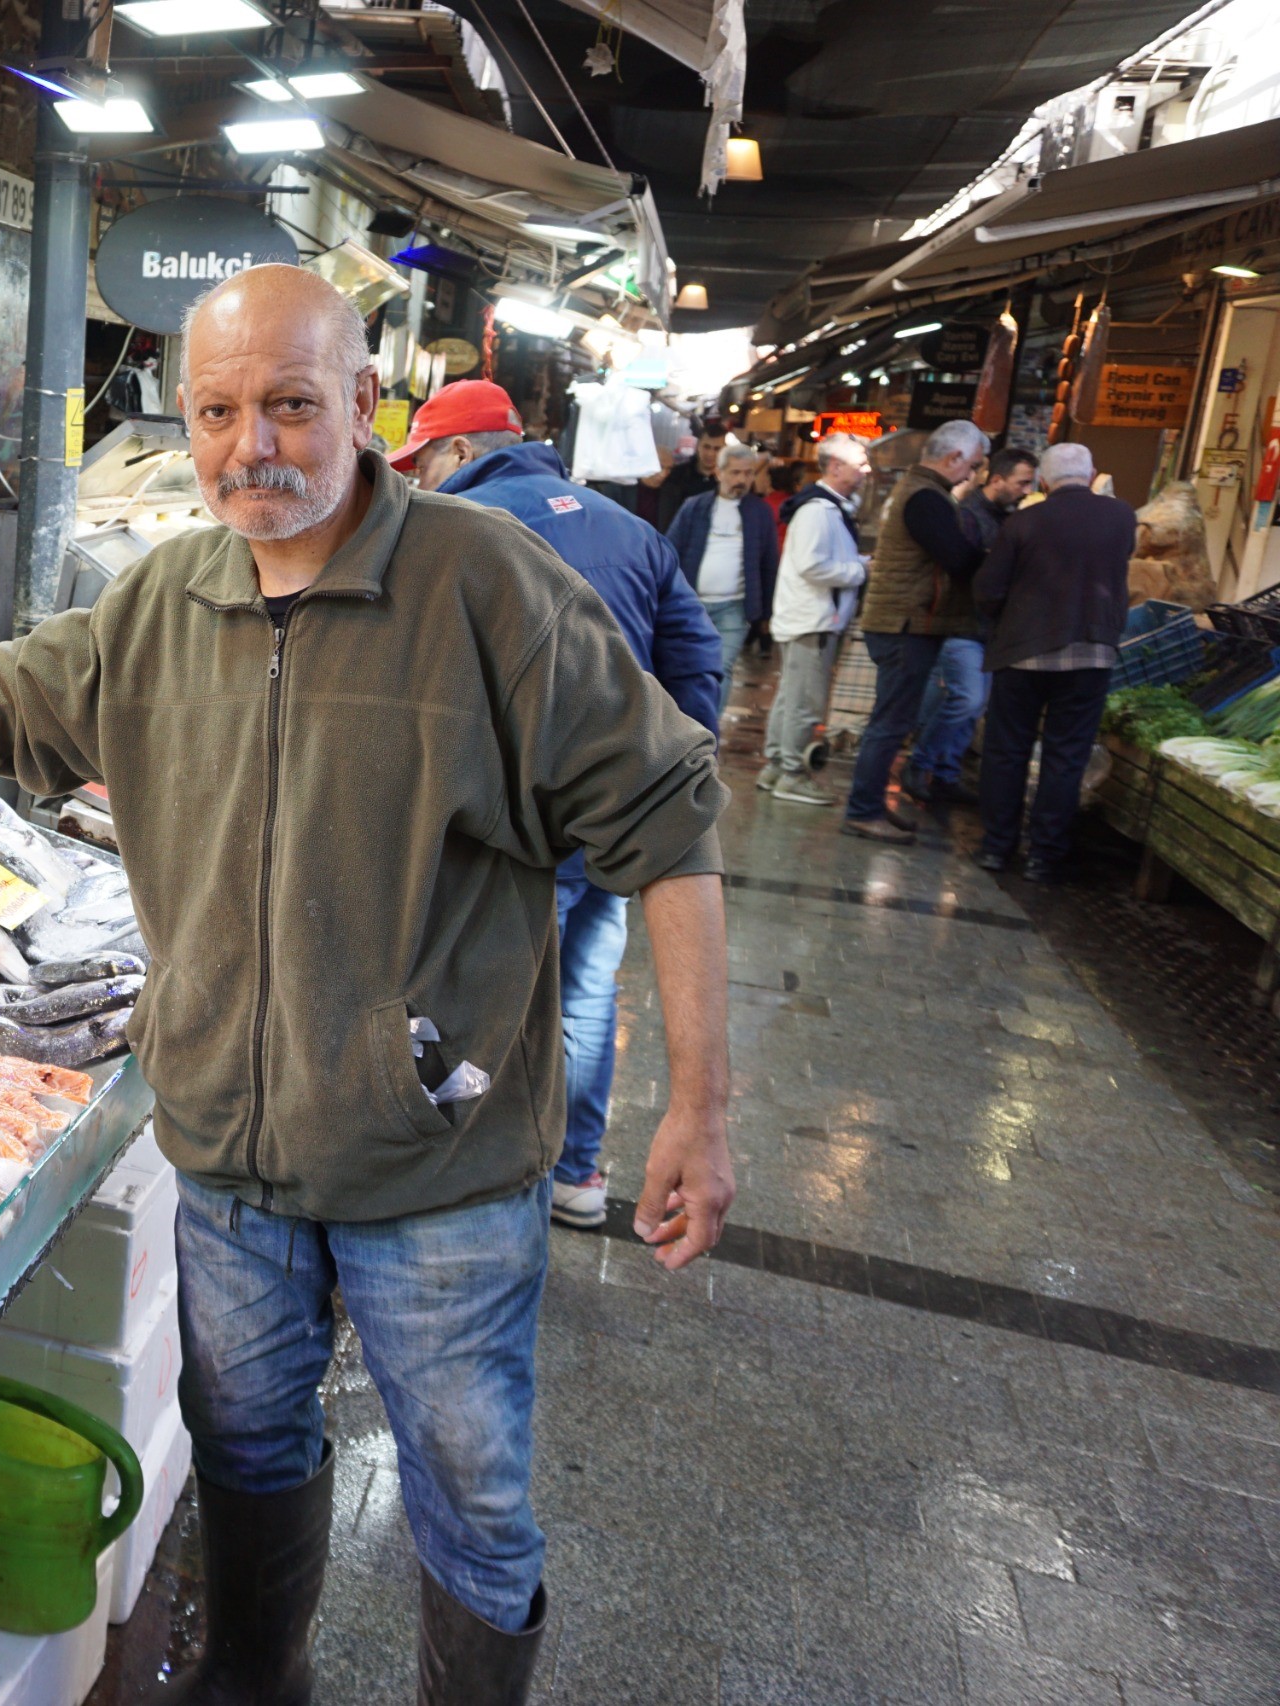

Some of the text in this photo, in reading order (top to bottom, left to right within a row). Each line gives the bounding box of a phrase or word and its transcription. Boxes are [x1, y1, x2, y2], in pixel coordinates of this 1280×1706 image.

[11, 183, 26, 223] 89
[1152, 372, 1182, 385] Can
[1158, 392, 1176, 402] ve
